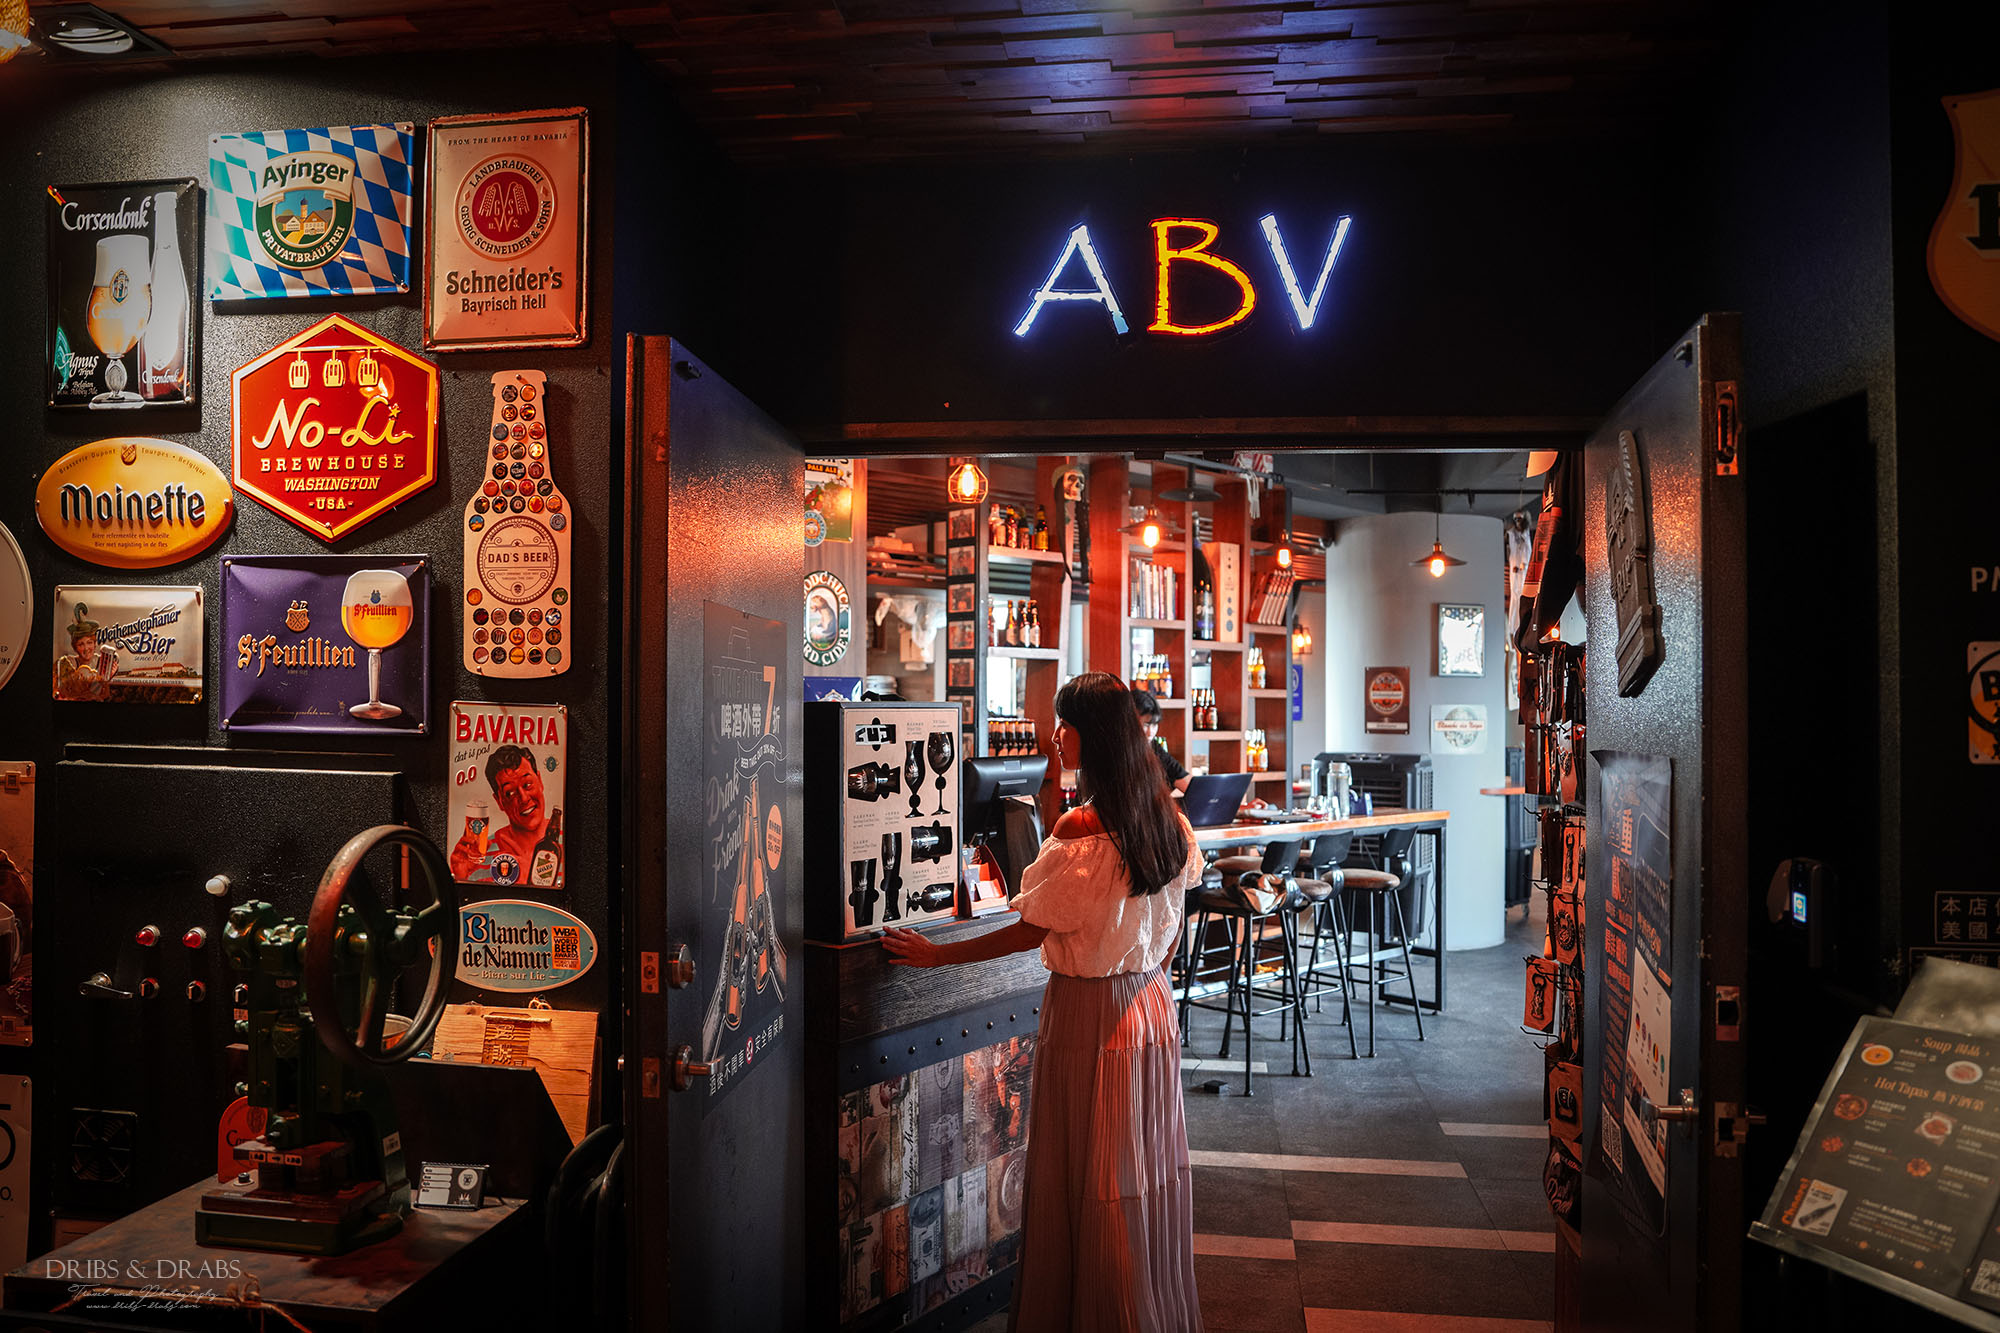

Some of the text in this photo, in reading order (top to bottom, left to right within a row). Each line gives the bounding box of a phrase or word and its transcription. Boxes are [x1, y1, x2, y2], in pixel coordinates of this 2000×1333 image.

[491, 135, 517, 143] HEART
[533, 133, 568, 141] BAVARIA
[263, 158, 350, 188] Ayinger
[469, 160, 544, 188] LANDBRAUEREI
[61, 196, 151, 231] Corsendonk
[460, 200, 552, 255] GEORG SCHNEIDER & SOHN
[262, 225, 346, 263] PRIVATBRAUEREI
[446, 266, 562, 295] Schneider's
[1013, 212, 1352, 337] ABV
[461, 293, 546, 315] Bayrisch Hell
[252, 395, 414, 449] No-Li
[261, 455, 405, 471] BREWHOUSE
[807, 463, 838, 474] PALE ALE
[285, 477, 380, 491] WASHINGTON
[58, 482, 205, 524] Moinette
[488, 552, 549, 564] DAD'S BEER
[1616, 554, 1632, 602] RIP
[95, 603, 181, 645] Weihenstephaner
[137, 632, 176, 655] Bier
[821, 628, 849, 665] CIDER
[456, 712, 559, 745] BAVARIA
[454, 744, 491, 763] dat is pas
[455, 765, 477, 786] 0.0
[492, 854, 518, 868] BAVARIA
[464, 912, 549, 946] Blanche
[553, 928, 577, 937] WBA
[463, 943, 551, 969] de Namur
[554, 944, 577, 953] BEER
[510, 972, 526, 980] sur
[530, 971, 546, 981] Lie
[1923, 1037, 1951, 1054] Soup
[1874, 1076, 1900, 1094] Hot
[1898, 1081, 1929, 1099] Tapas
